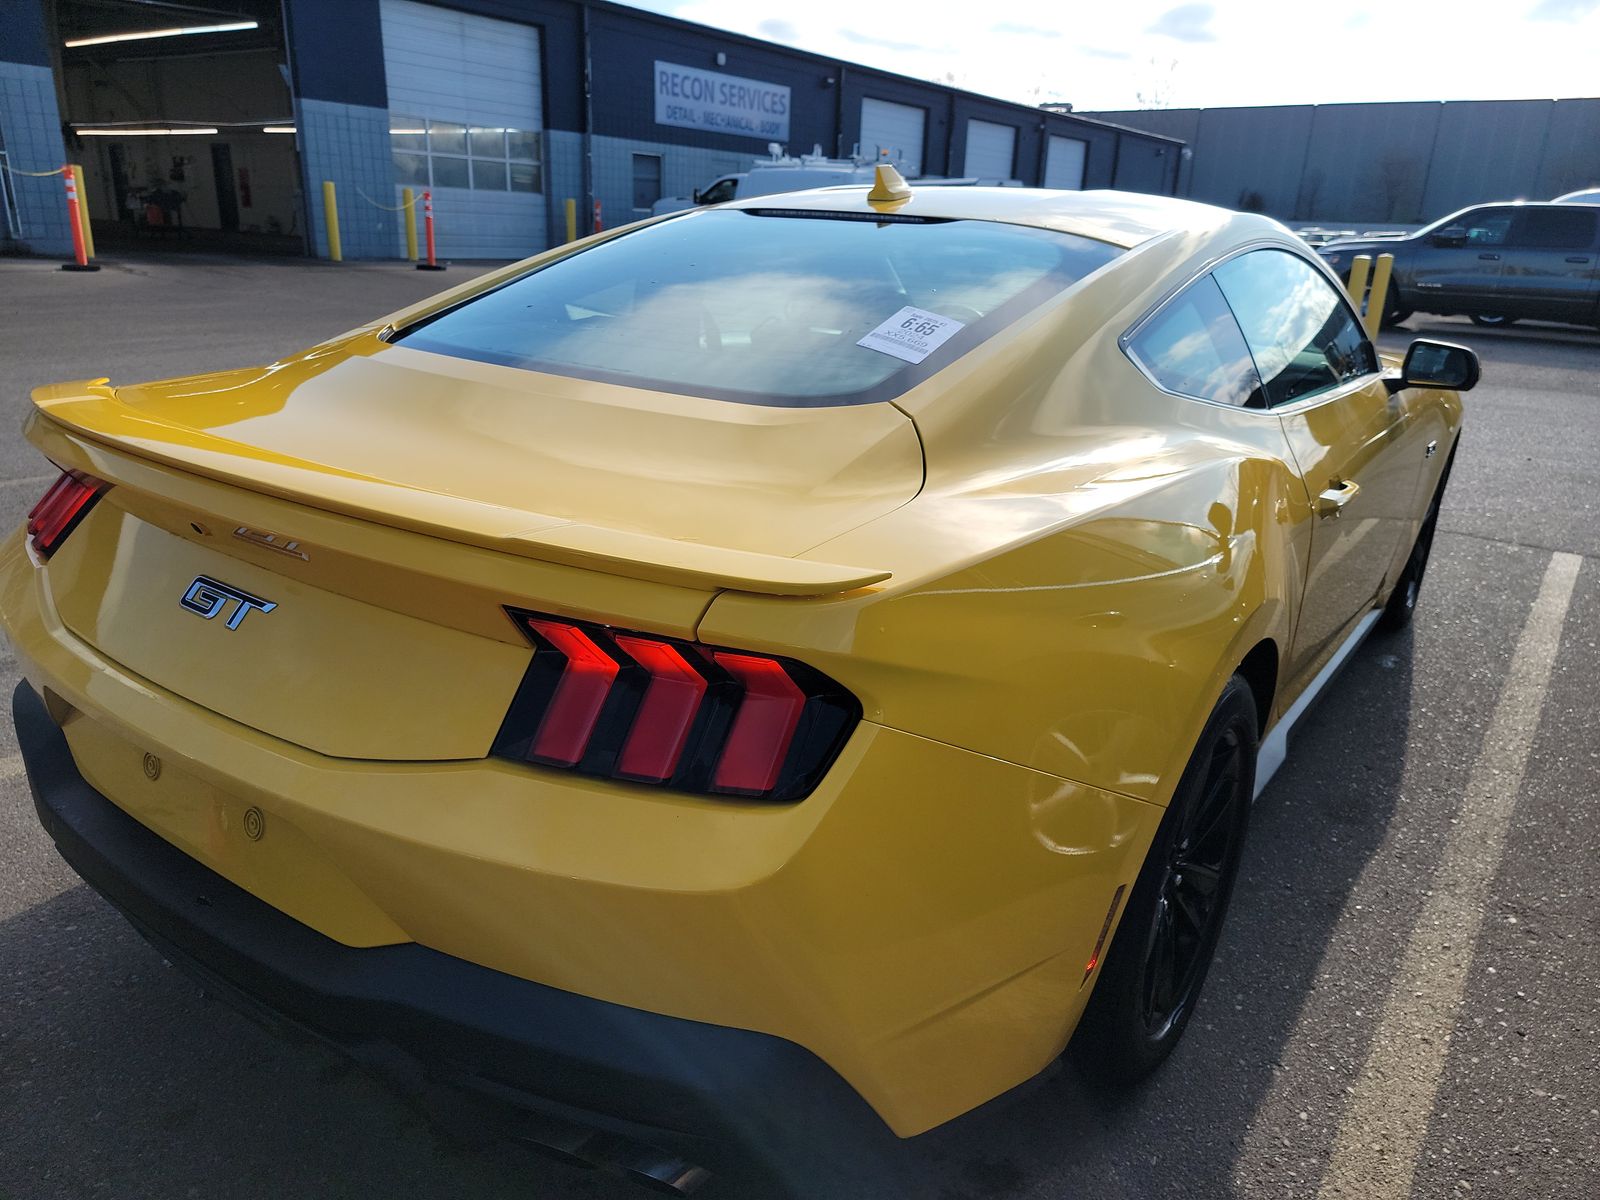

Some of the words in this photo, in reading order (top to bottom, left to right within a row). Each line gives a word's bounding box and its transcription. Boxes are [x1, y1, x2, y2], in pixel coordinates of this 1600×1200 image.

[659, 71, 715, 104] RECON
[719, 83, 786, 115] SERVICES
[665, 105, 696, 123] DETAIL
[703, 111, 754, 132] MECHANICAL
[900, 317, 940, 336] 6:65
[179, 574, 279, 632] GT
